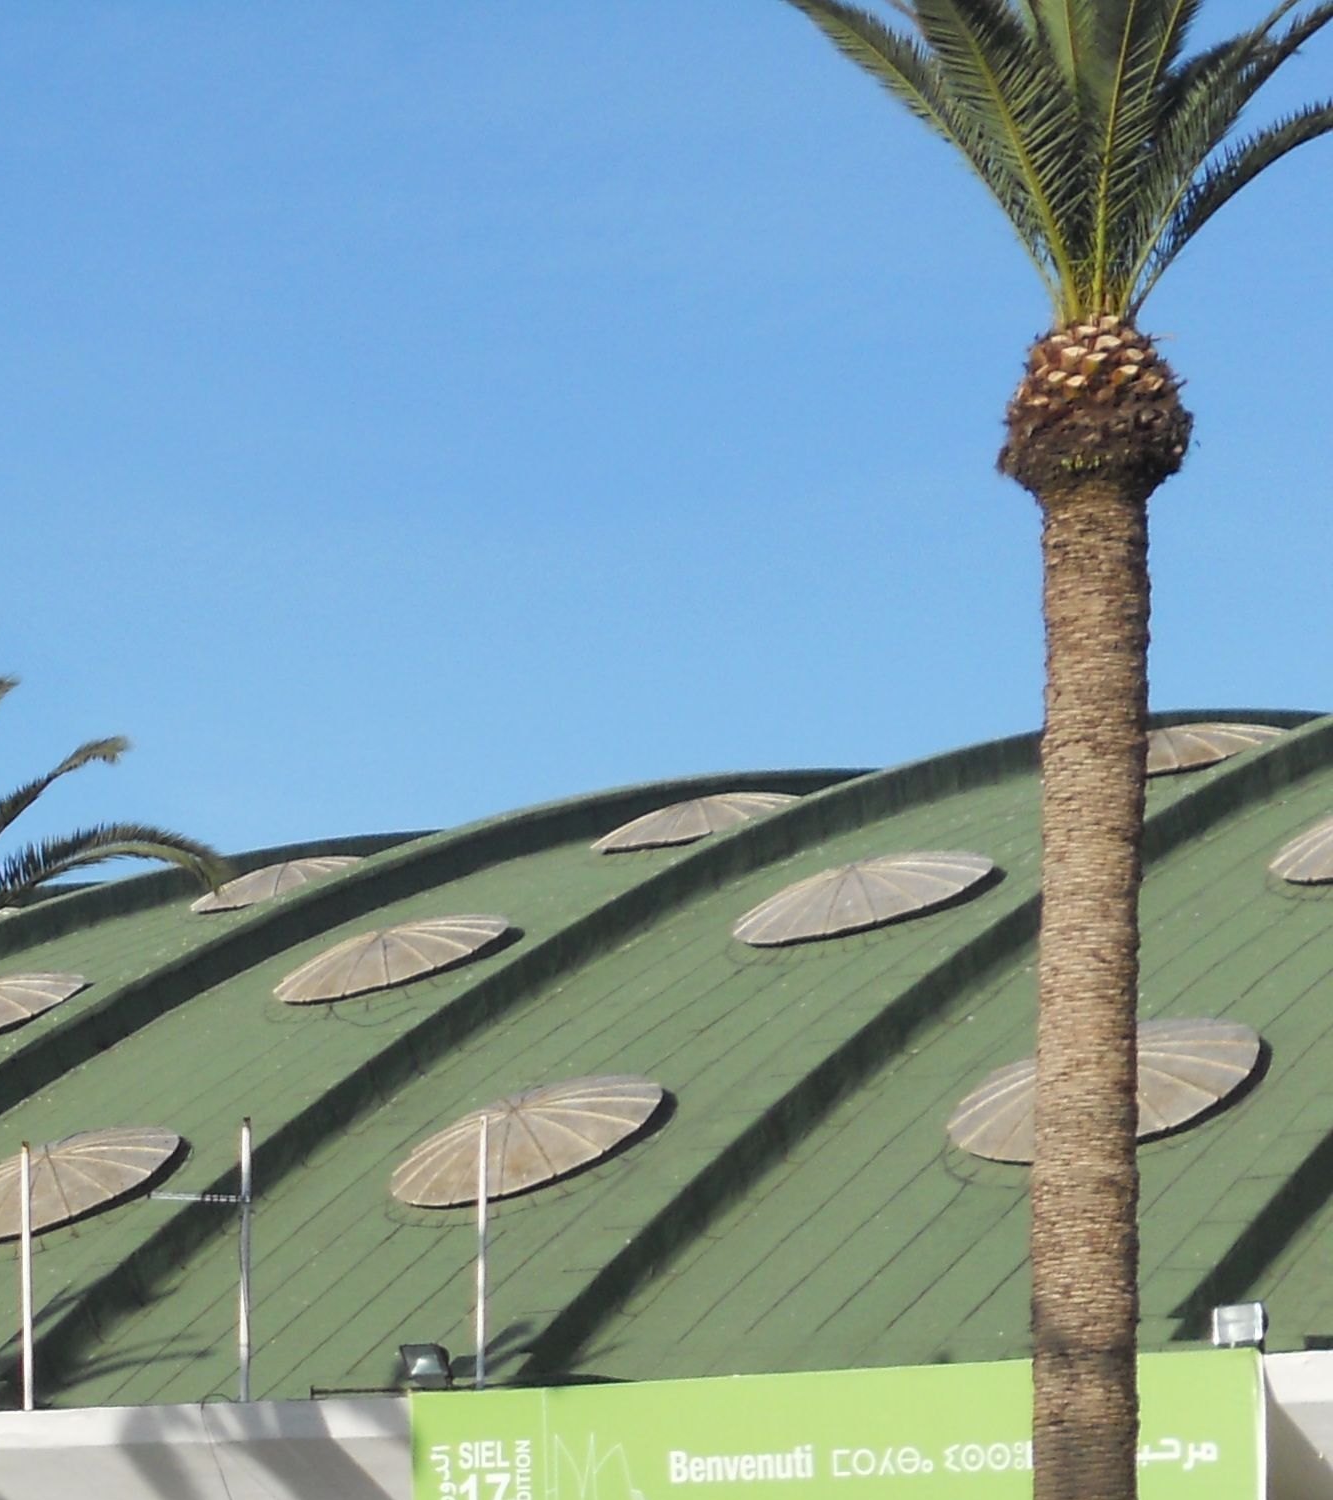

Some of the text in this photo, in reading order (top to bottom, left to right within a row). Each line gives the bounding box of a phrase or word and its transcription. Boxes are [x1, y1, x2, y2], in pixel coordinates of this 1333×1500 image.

[459, 1440, 510, 1469] SIEL
[668, 1444, 813, 1483] Benvenuti
[1135, 1437, 1219, 1471] مرحب
